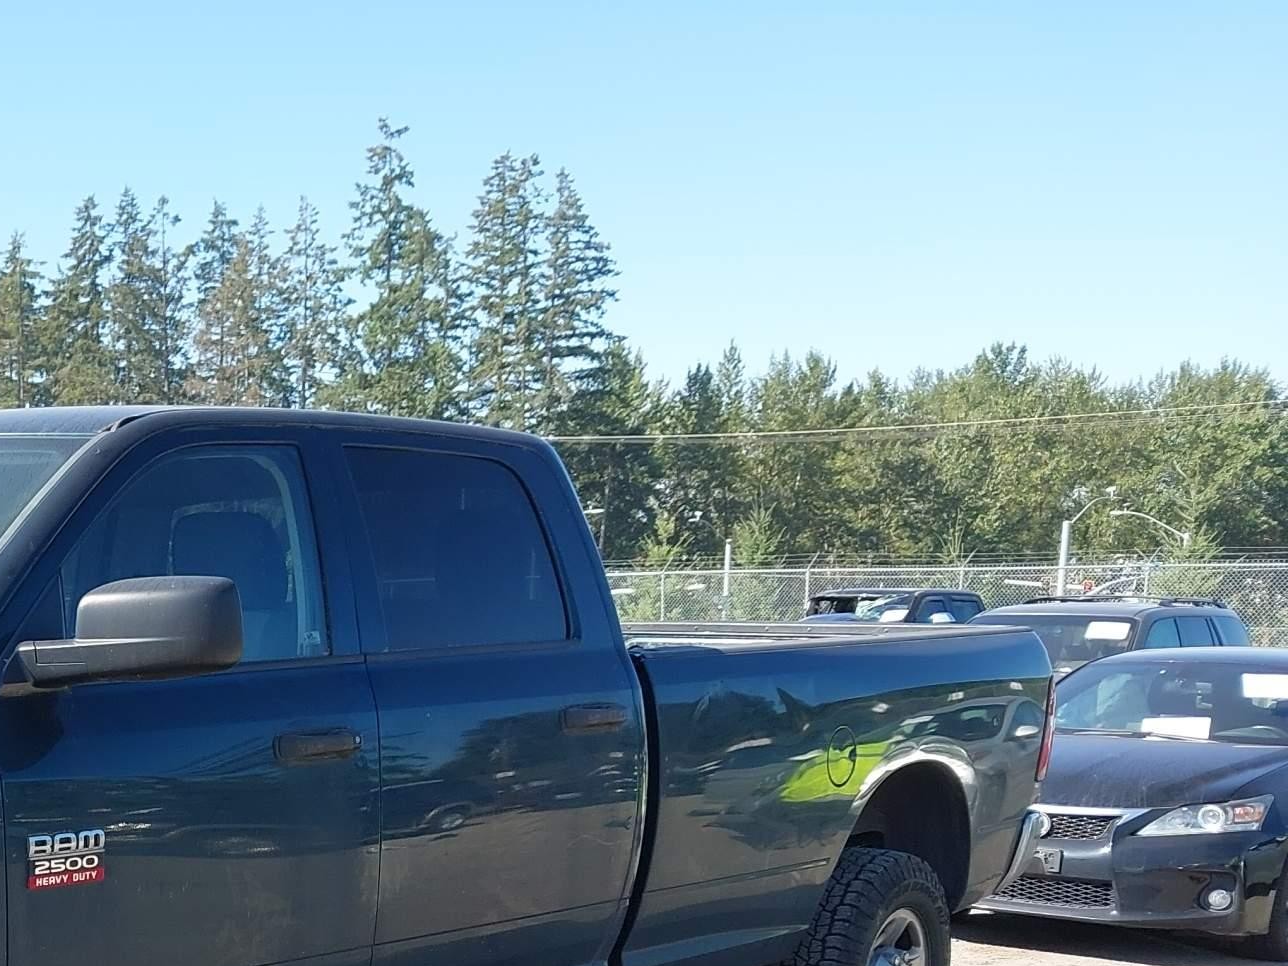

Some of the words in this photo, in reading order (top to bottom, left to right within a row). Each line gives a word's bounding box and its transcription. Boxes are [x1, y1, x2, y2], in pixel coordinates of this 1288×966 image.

[28, 829, 106, 857] RAM
[34, 855, 99, 875] 2500
[35, 874, 69, 887] HEAVY
[72, 870, 98, 882] DUTY
